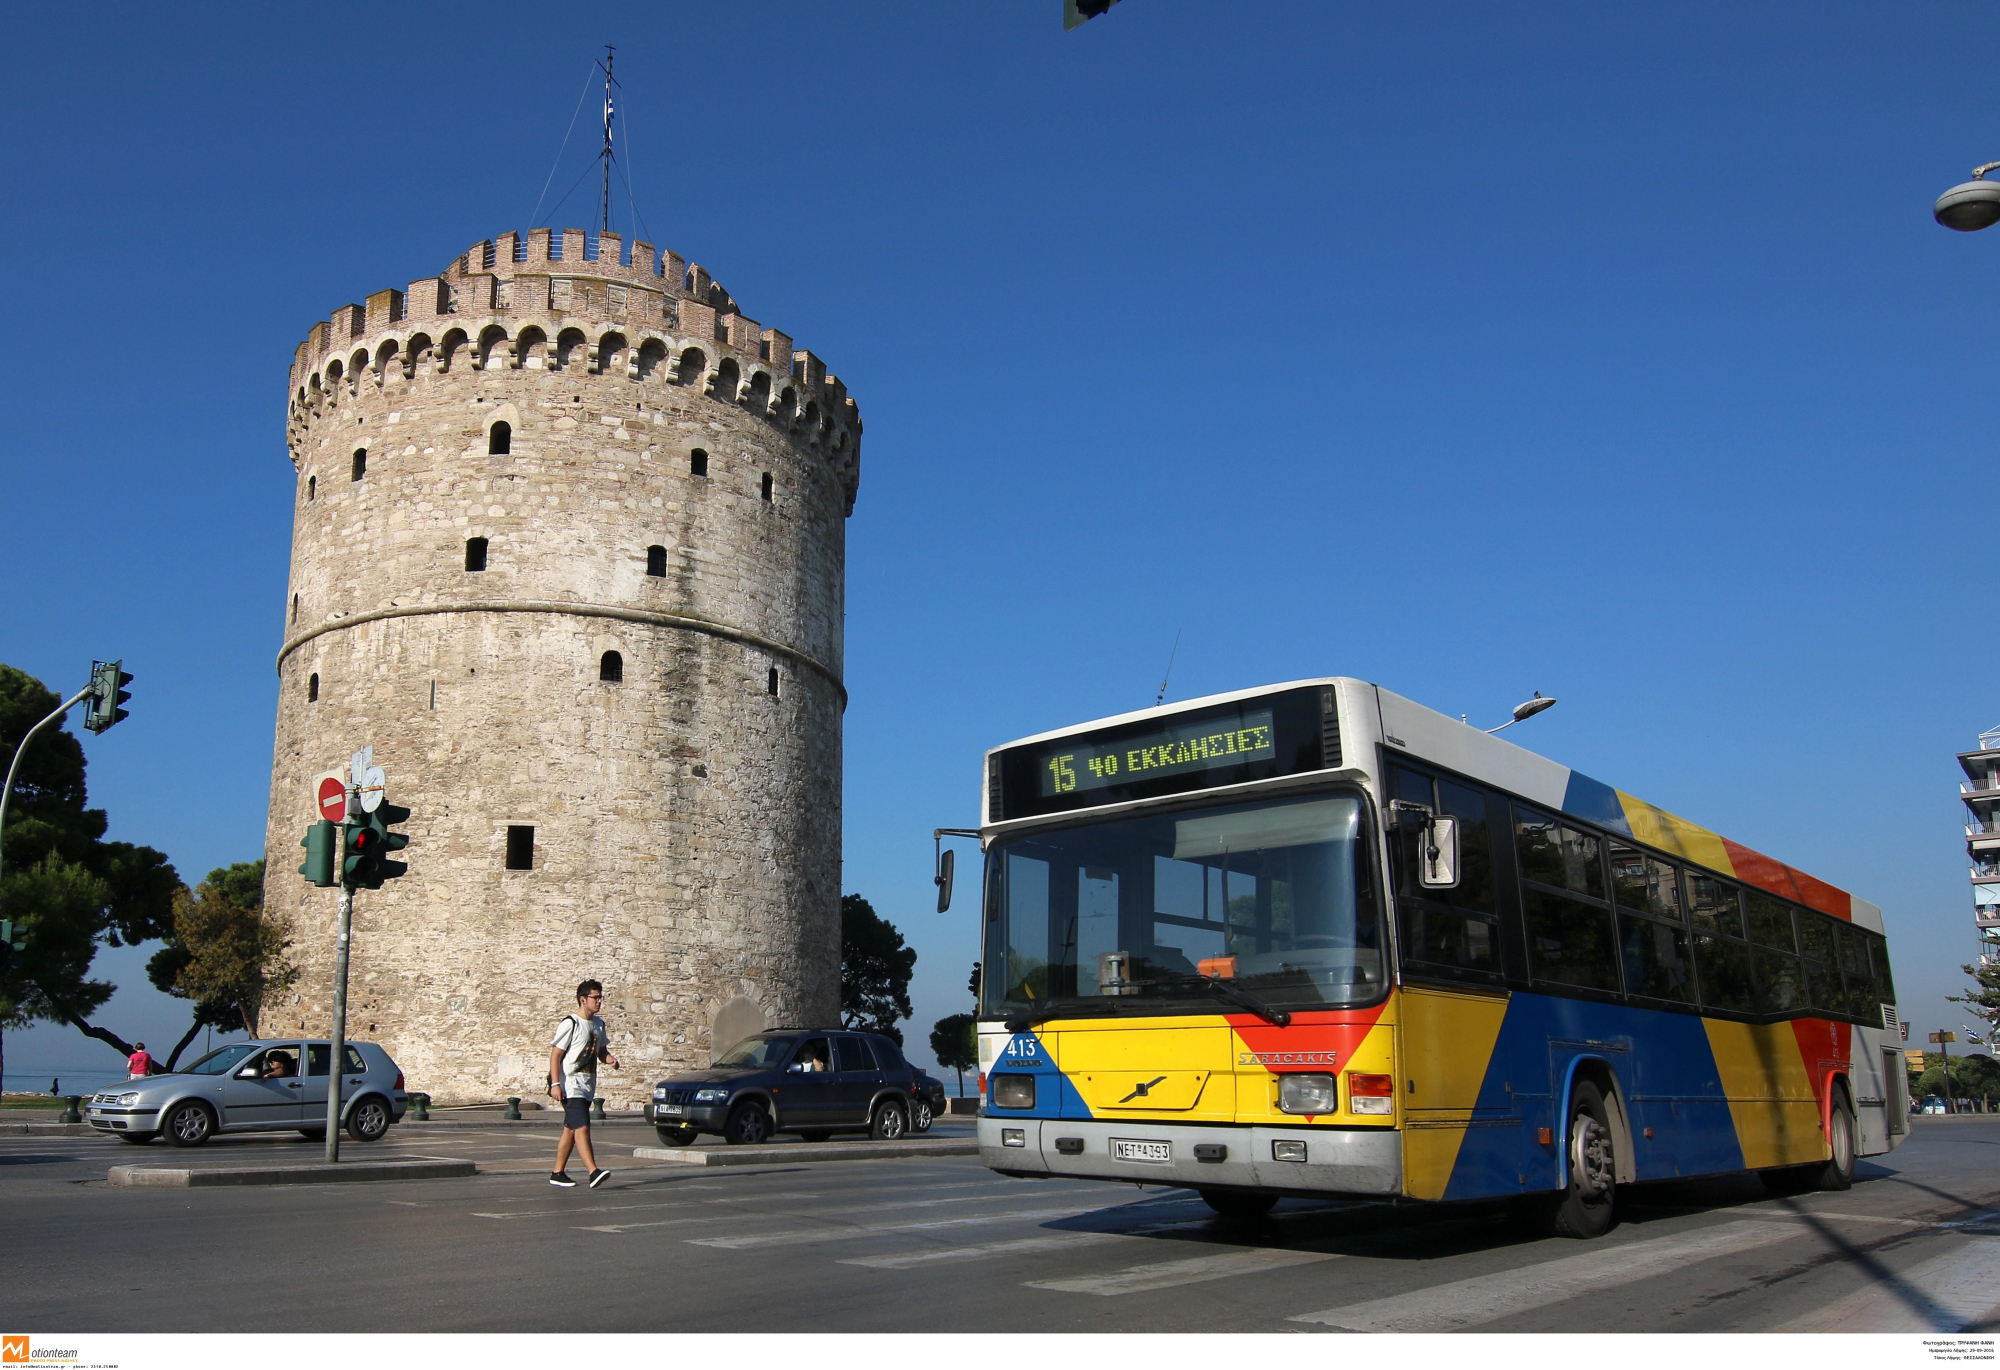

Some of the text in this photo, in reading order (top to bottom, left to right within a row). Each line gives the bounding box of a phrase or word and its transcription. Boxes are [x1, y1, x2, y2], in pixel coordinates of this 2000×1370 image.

[1049, 754, 1076, 793] 15
[1127, 725, 1270, 772] ΕΚΚΛΗΣΙΕΣ
[1007, 1039, 1036, 1057] 413
[1238, 1052, 1337, 1065] SARACAKIS
